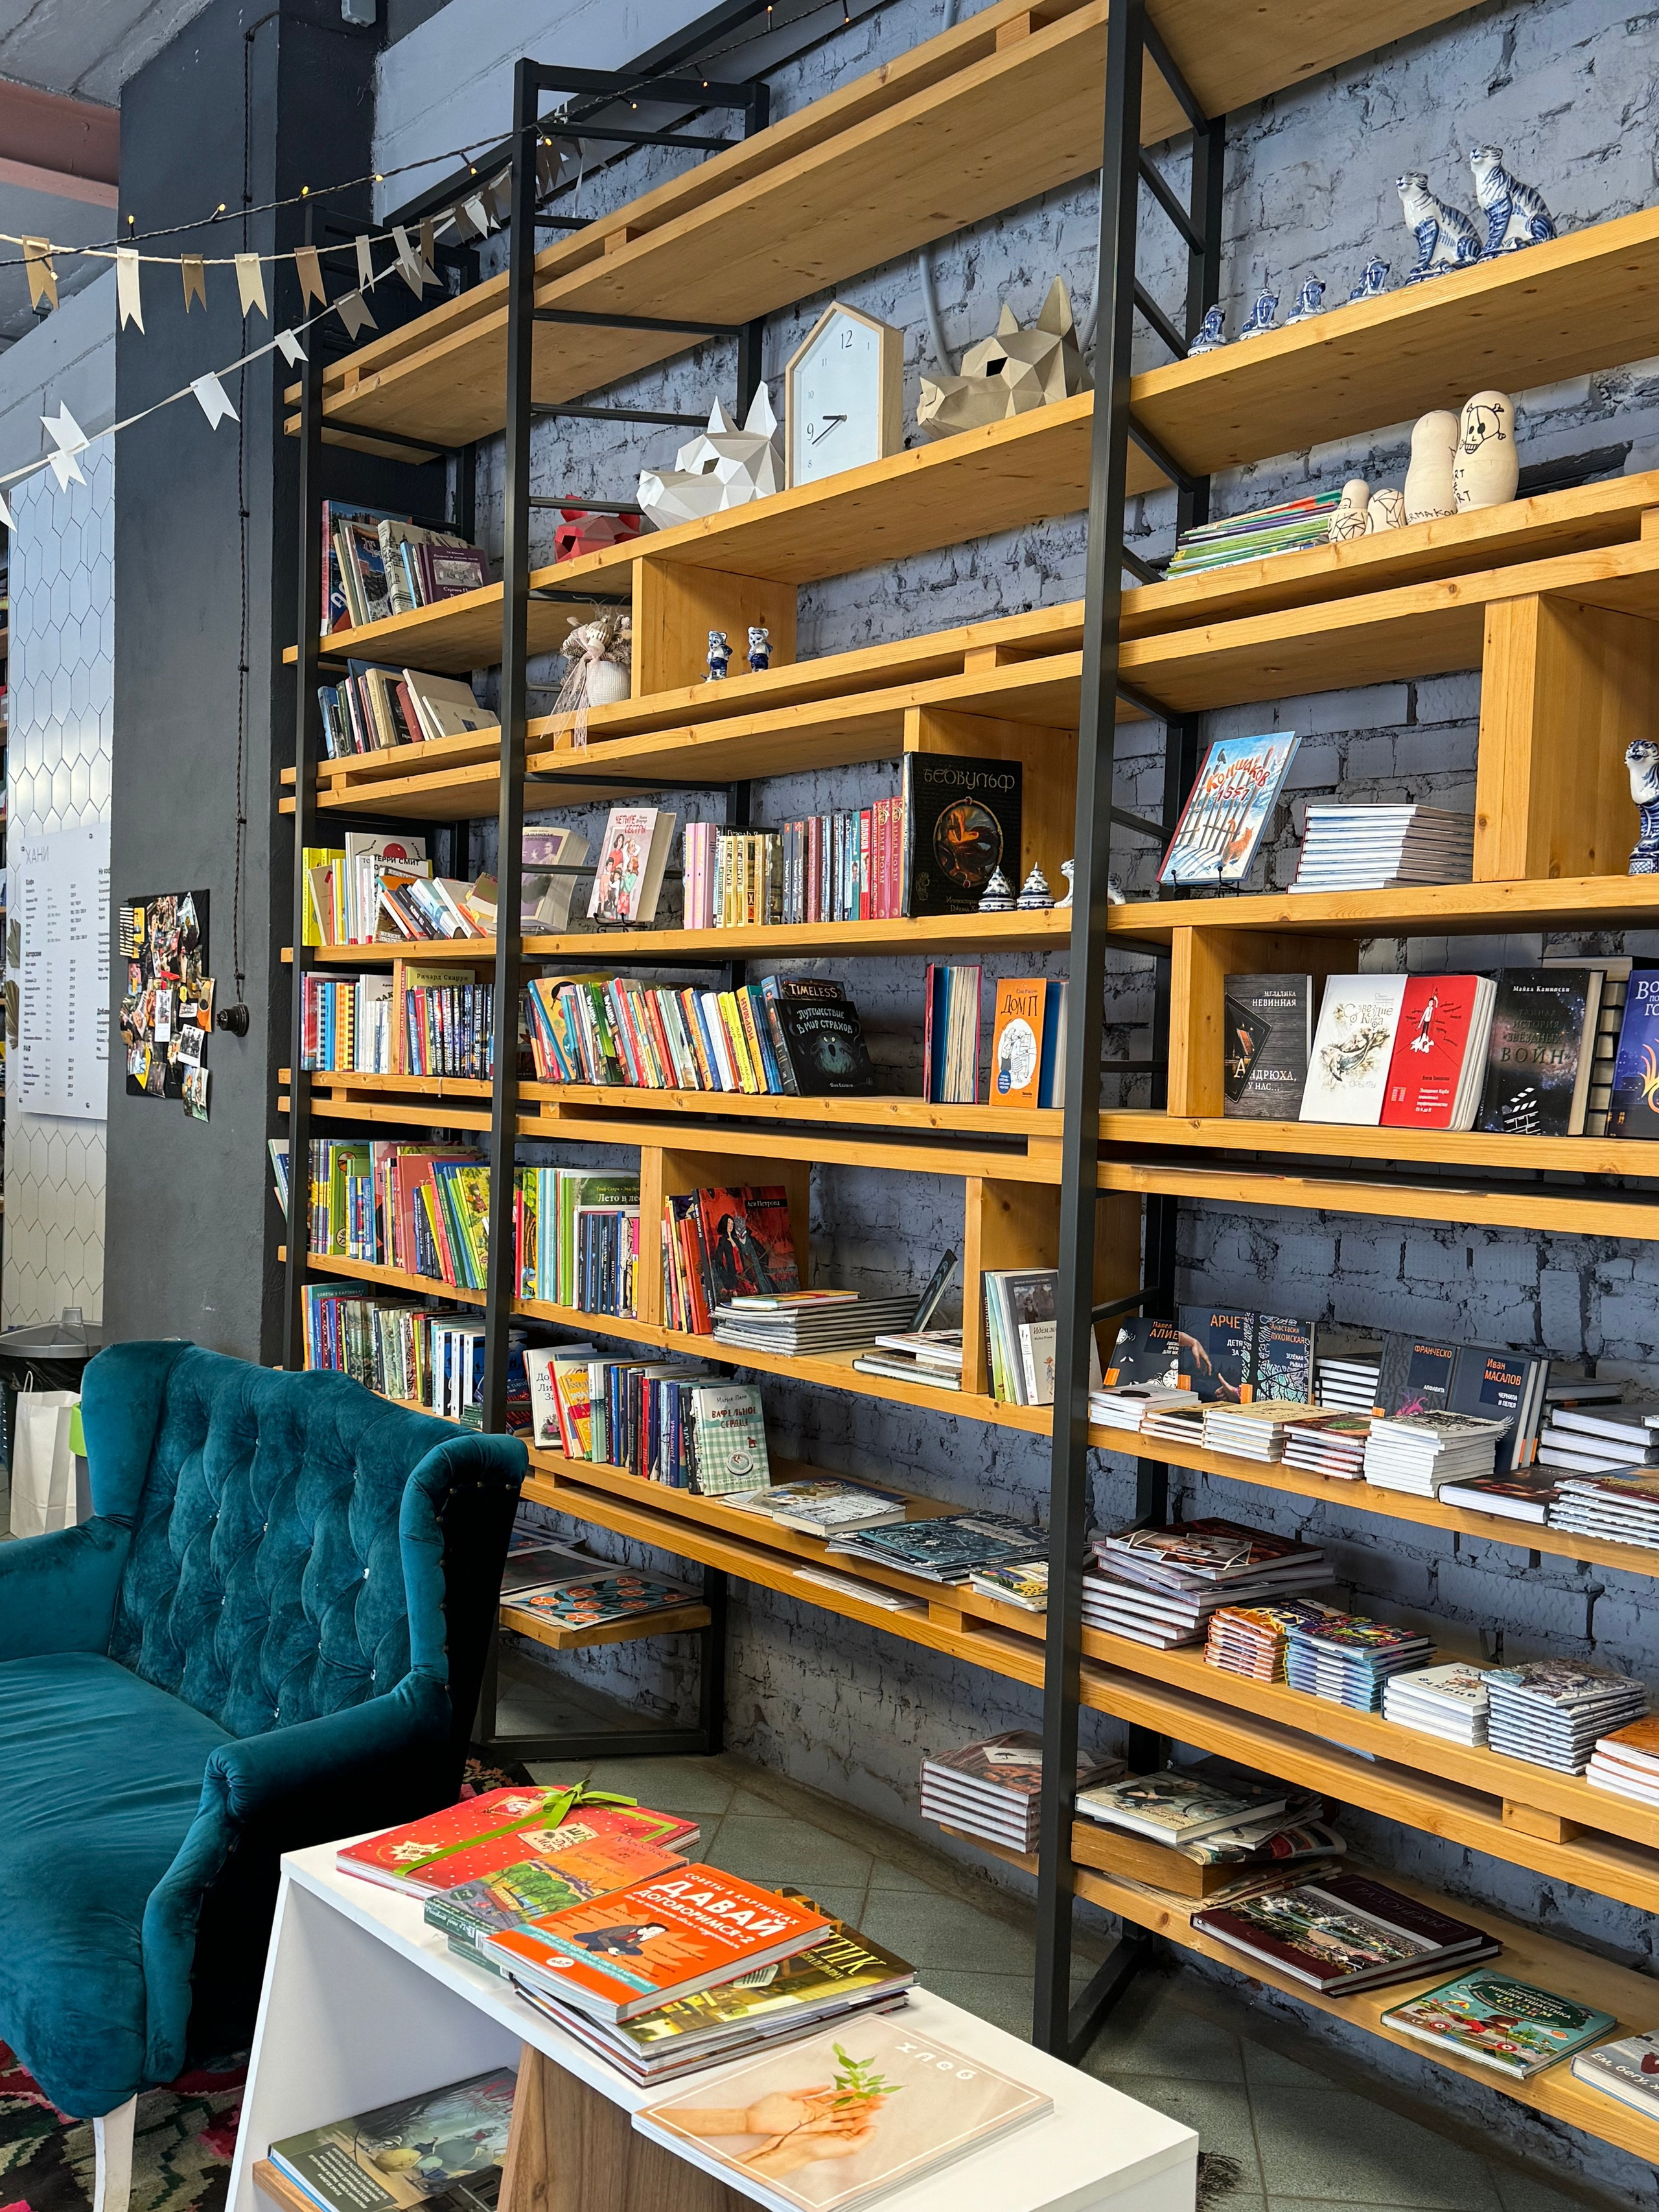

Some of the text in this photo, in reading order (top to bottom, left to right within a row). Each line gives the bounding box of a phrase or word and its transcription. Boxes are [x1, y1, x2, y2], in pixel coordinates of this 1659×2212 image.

[841, 330, 853, 349] 12
[807, 423, 814, 441] 9
[923, 768, 1015, 793] БЕОВУЛЬФ
[1206, 755, 1271, 793] КОНШАКОВ
[616, 815, 637, 825] ЧЕТЫРЕ
[624, 825, 647, 834] СЕСТРЫ
[861, 819, 869, 850] ПОЛЯКОВ
[374, 855, 420, 867] ТЕРРИ СМИТ
[788, 983, 839, 998] TIMELESS
[796, 1007, 845, 1020] ПУТЕШЕСТВИЕ
[804, 1021, 820, 1033] МИР
[820, 1019, 853, 1034] СТРАХОВ
[1512, 1020, 1560, 1029] ИСТОРИЯ
[597, 1193, 620, 1203] Лето
[1211, 1314, 1244, 1329] АРЧЕ
[1149, 1329, 1179, 1340] АЛИЕ
[1414, 1345, 1453, 1359] ФРАНЧЕСКО
[1487, 1358, 1505, 1371] Иван
[536, 1373, 550, 1382] До
[1484, 1370, 1522, 1386] МАСАЛОВ
[712, 1406, 757, 1419] ВАФЕЛЬНОЕ
[721, 1418, 749, 1429] СЕРДЦЕ
[685, 1872, 726, 1892] СОВЕТЫ
[734, 1893, 800, 1926] КАРТИНКАХ
[632, 1889, 756, 1944] ДОГОВОРИМСЯ-2
[649, 1880, 787, 1938] ДАВАЙ
[1489, 1985, 1524, 2002] МИШКИ
[1523, 1996, 1572, 2020] УШАСТИКА
[1508, 1987, 1564, 2010] ПРИКЛЮЧЕНИЯ
[1591, 2052, 1649, 2085] Ем, бегу,
